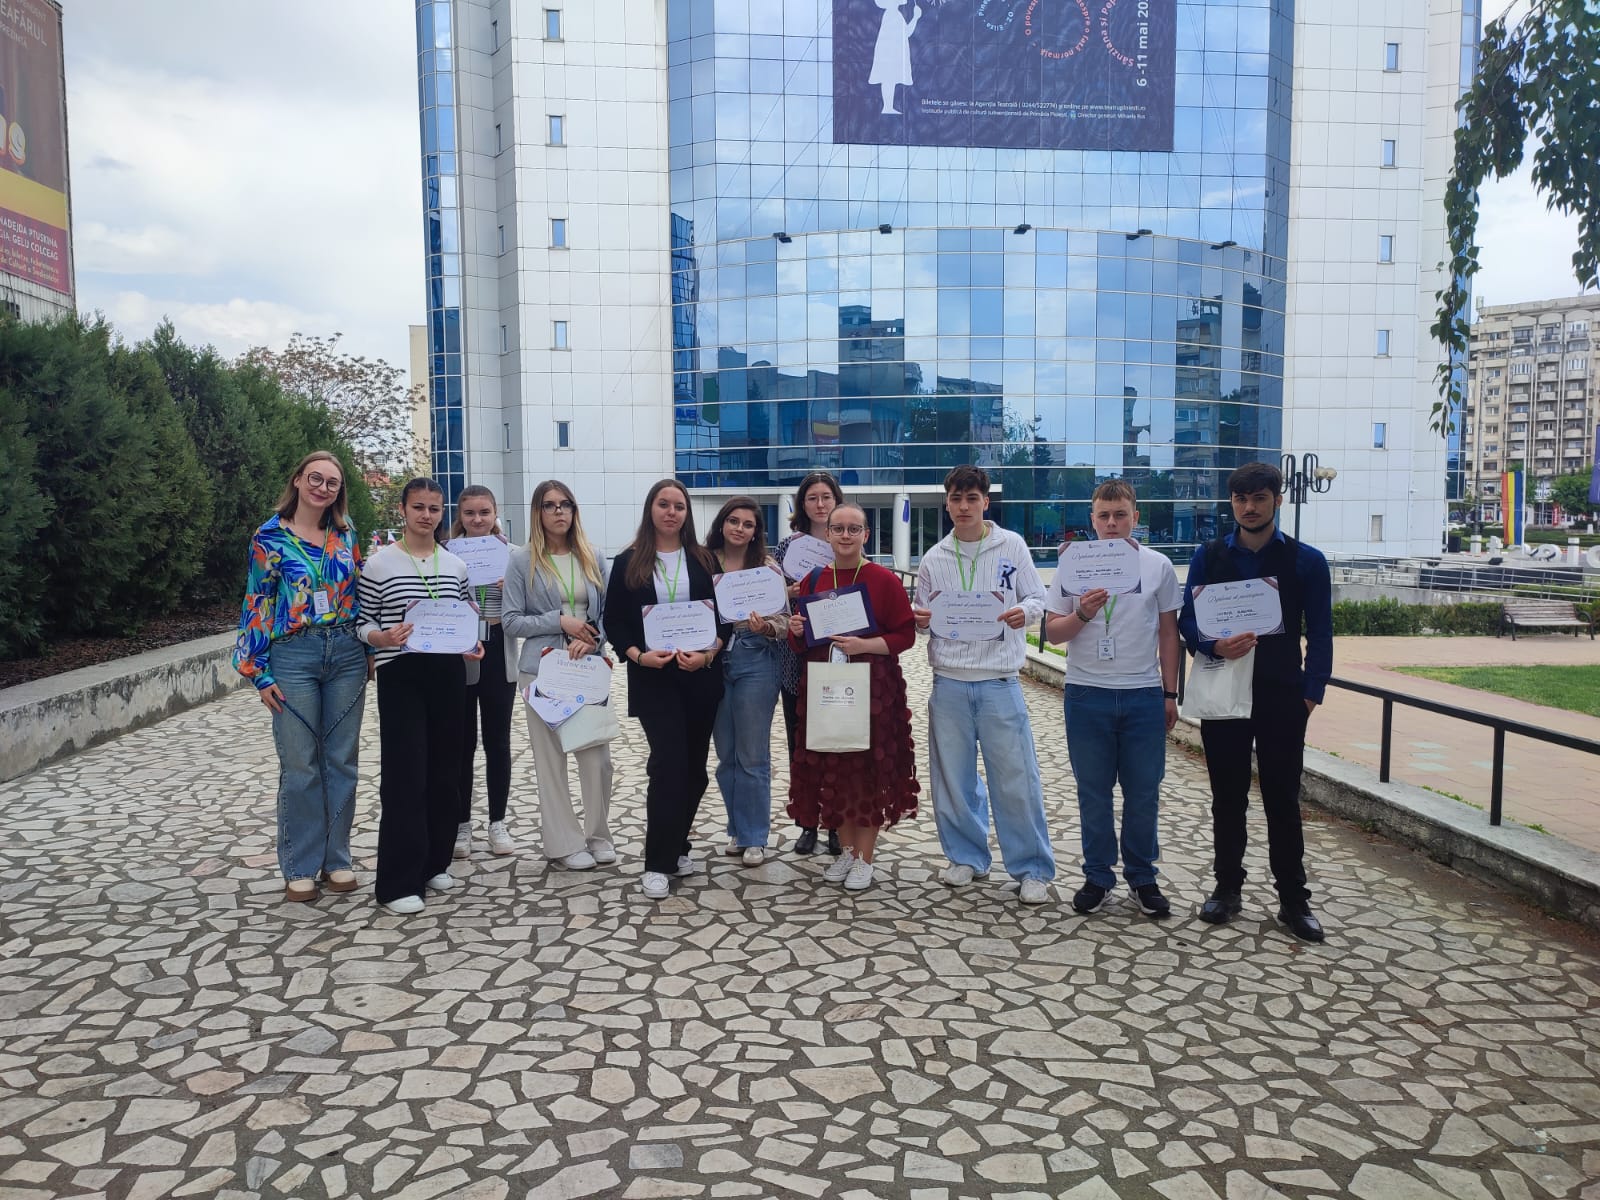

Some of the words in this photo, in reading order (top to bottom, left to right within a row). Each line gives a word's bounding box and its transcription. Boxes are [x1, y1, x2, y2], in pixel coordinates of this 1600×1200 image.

[1137, 0, 1149, 19] 20
[1136, 22, 1149, 50] mai
[12, 234, 30, 249] GELU
[30, 242, 58, 261] COLCEAG
